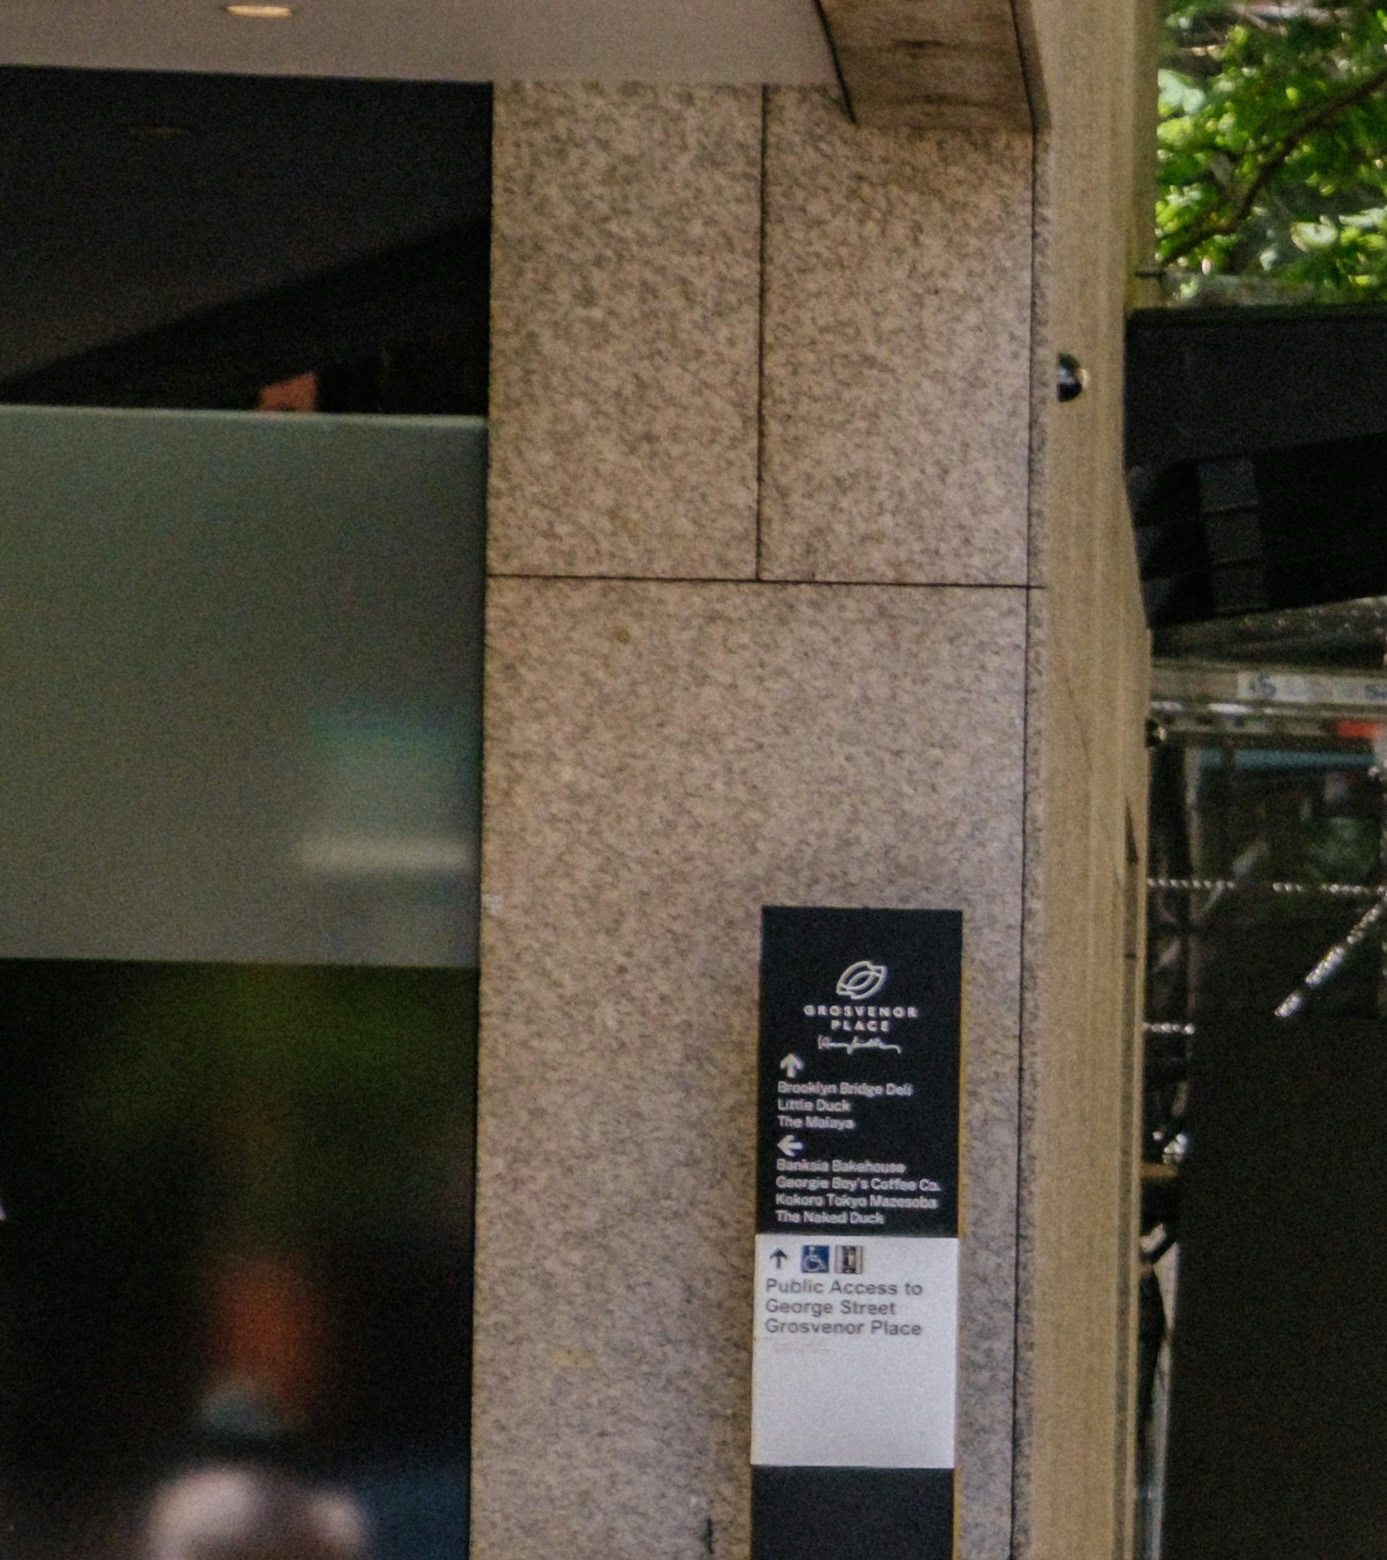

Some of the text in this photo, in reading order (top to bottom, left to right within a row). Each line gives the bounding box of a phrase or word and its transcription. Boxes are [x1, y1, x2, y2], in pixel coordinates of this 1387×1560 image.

[803, 1005, 919, 1018] GROSVENOR
[830, 1019, 890, 1032] PLACE
[777, 1081, 914, 1098] Brooklyn Bridge Deli
[777, 1098, 850, 1113] Little Duck
[777, 1115, 803, 1128] The
[832, 1160, 907, 1175] Bakehouse
[870, 1177, 916, 1191] Coffee
[919, 1178, 941, 1192] Co.
[775, 1209, 885, 1225] The Naked Duck
[765, 1278, 923, 1296] Public Access to
[765, 1298, 897, 1317] George Street
[765, 1318, 922, 1336] Grosvenor Place
